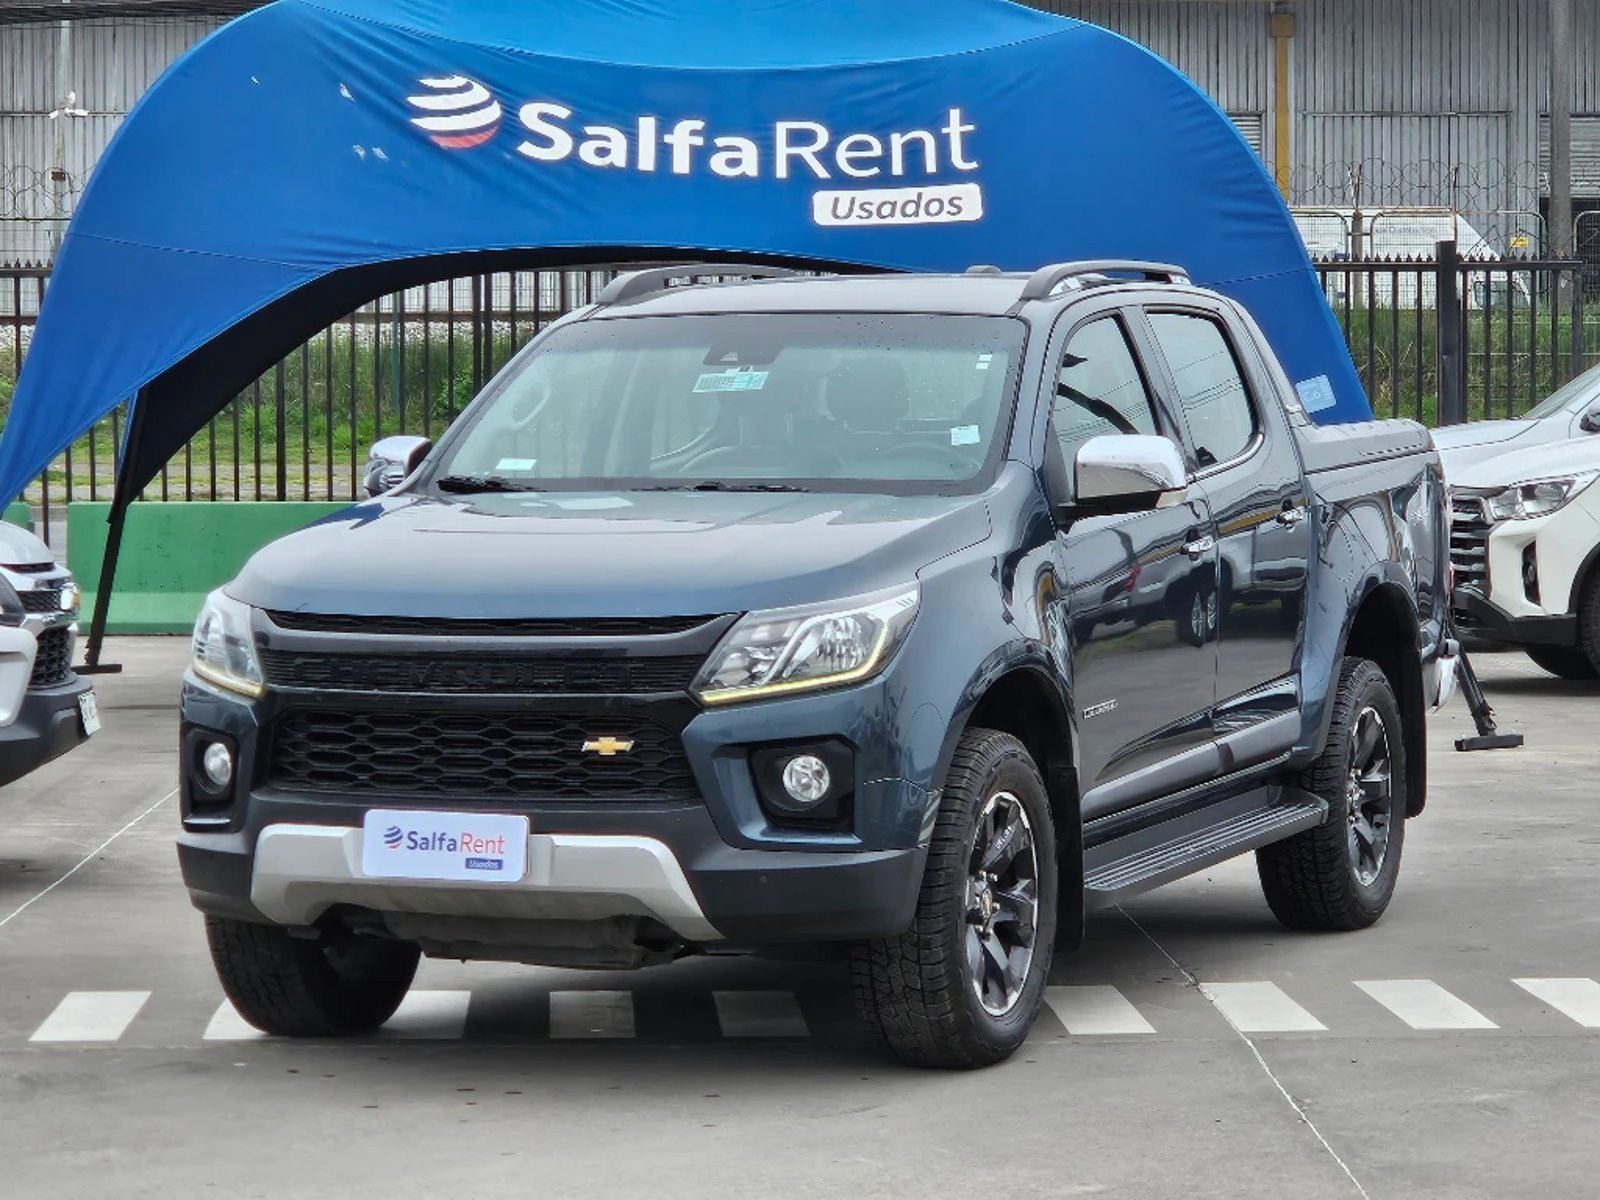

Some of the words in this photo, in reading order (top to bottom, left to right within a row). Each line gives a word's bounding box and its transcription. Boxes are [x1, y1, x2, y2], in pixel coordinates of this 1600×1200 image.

[516, 102, 979, 179] SalfaRent
[830, 191, 964, 221] Usados
[406, 831, 505, 854] SalfaRent
